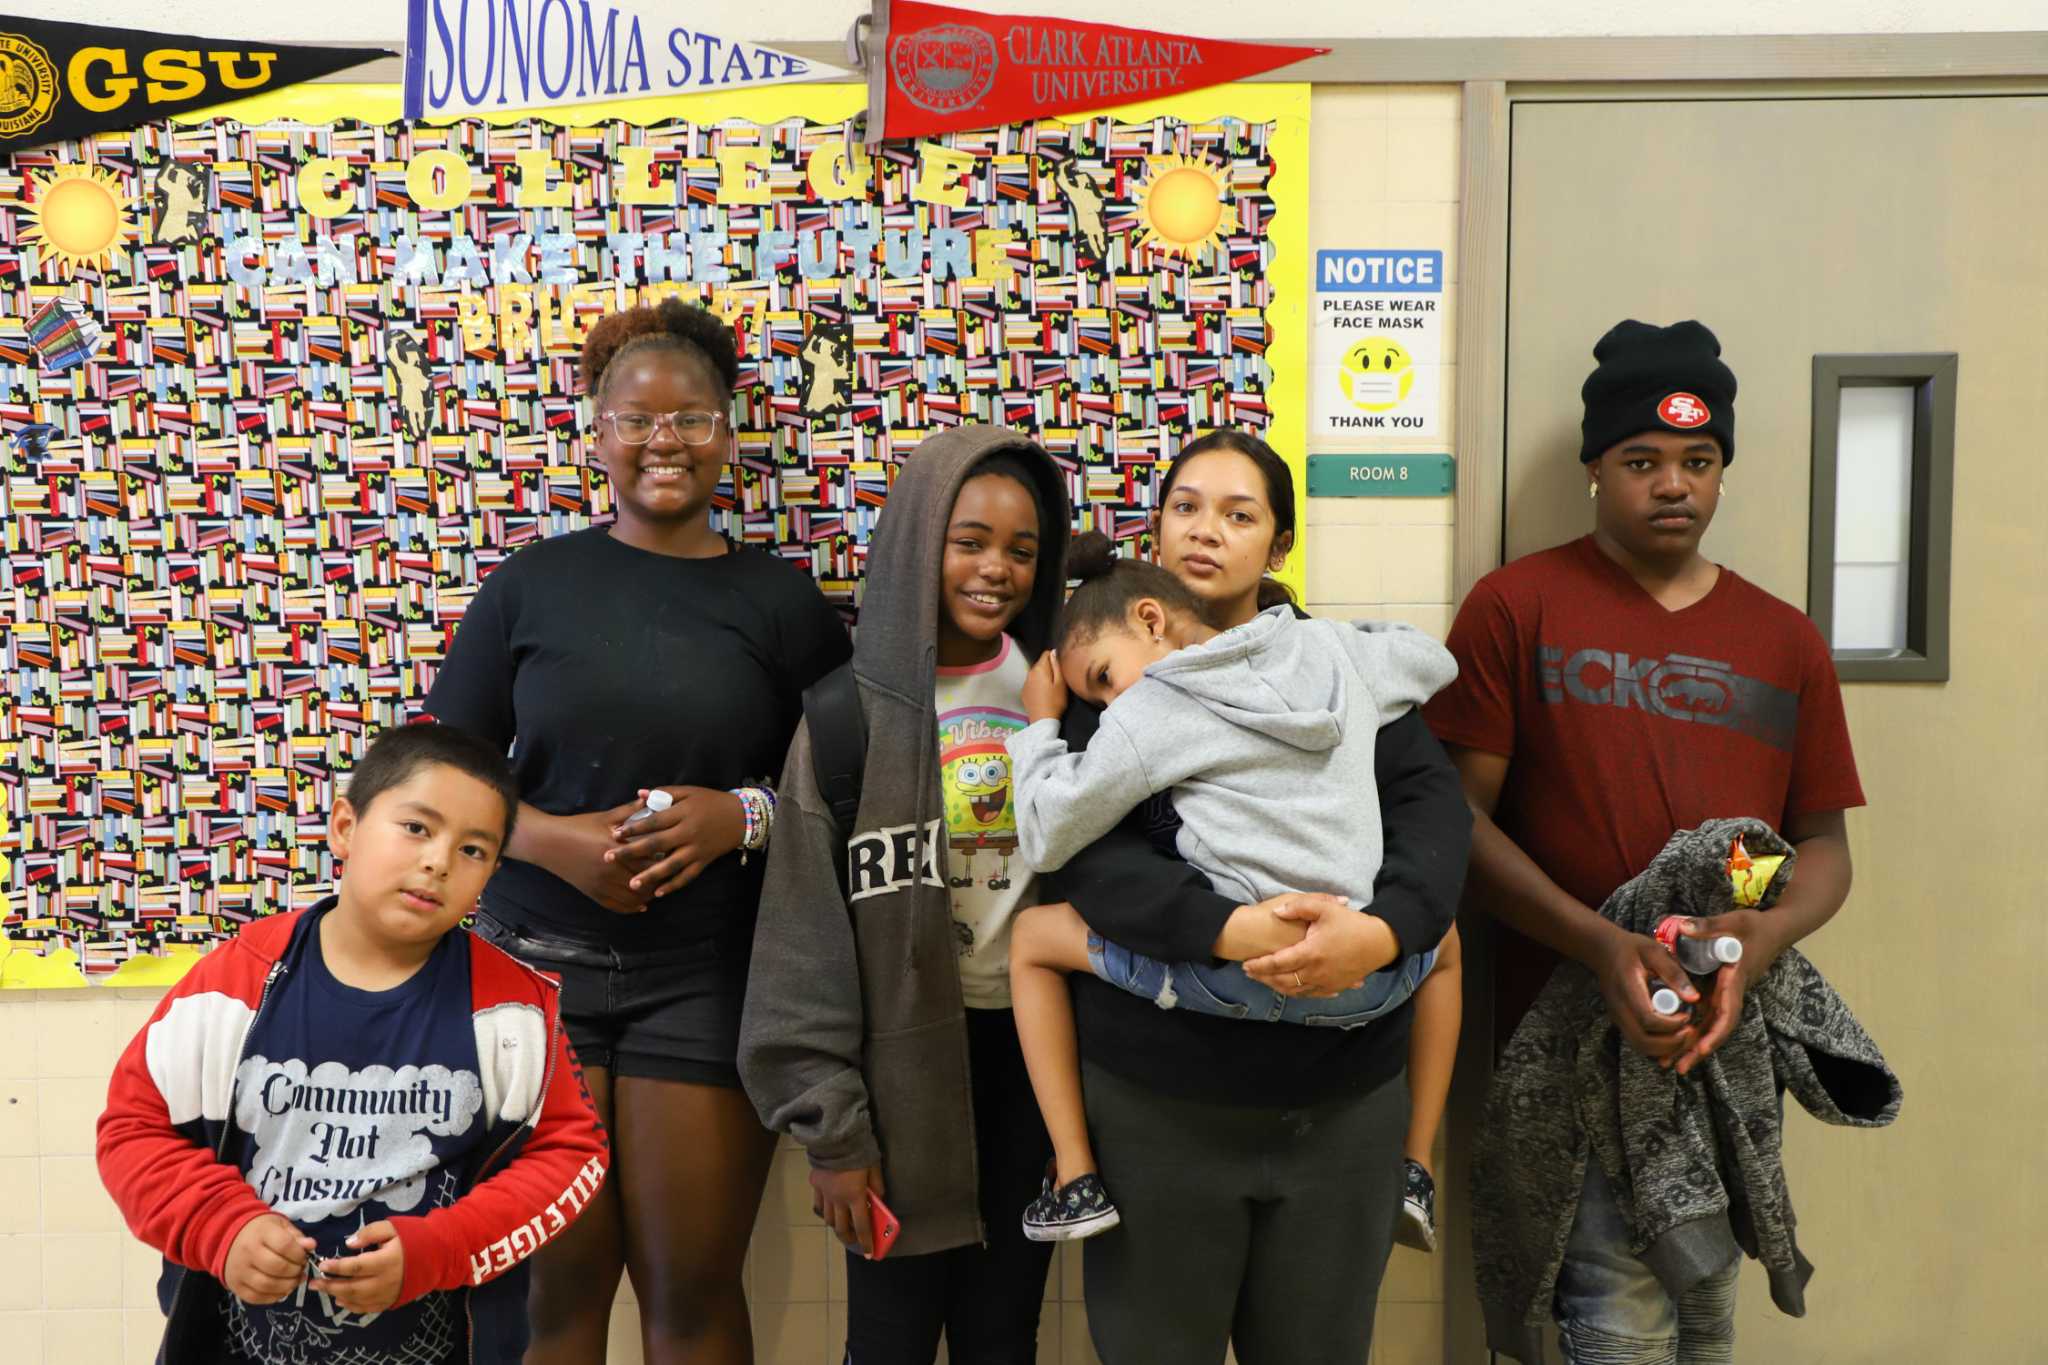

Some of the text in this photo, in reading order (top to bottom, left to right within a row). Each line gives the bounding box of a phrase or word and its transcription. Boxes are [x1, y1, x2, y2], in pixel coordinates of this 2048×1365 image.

[429, 0, 651, 109] SONOMA
[667, 27, 812, 87] STATE
[1007, 25, 1089, 66] CLARK
[1094, 33, 1205, 67] ATLANTA
[15, 42, 51, 96] UNIVERSITY
[66, 46, 278, 113] GSU
[297, 141, 975, 219] COLLEGE
[226, 228, 1015, 288] CAN MAKE THE FUTURE
[1324, 257, 1434, 284] NOTICE
[1323, 300, 1436, 312] PLEASE WEAR
[1333, 317, 1424, 328] FACE MASK
[1329, 416, 1424, 428] THANK YOU
[1349, 466, 1409, 481] ROOM 8
[310, 1121, 380, 1166] Not
[470, 1156, 606, 1286] HILFIGER
